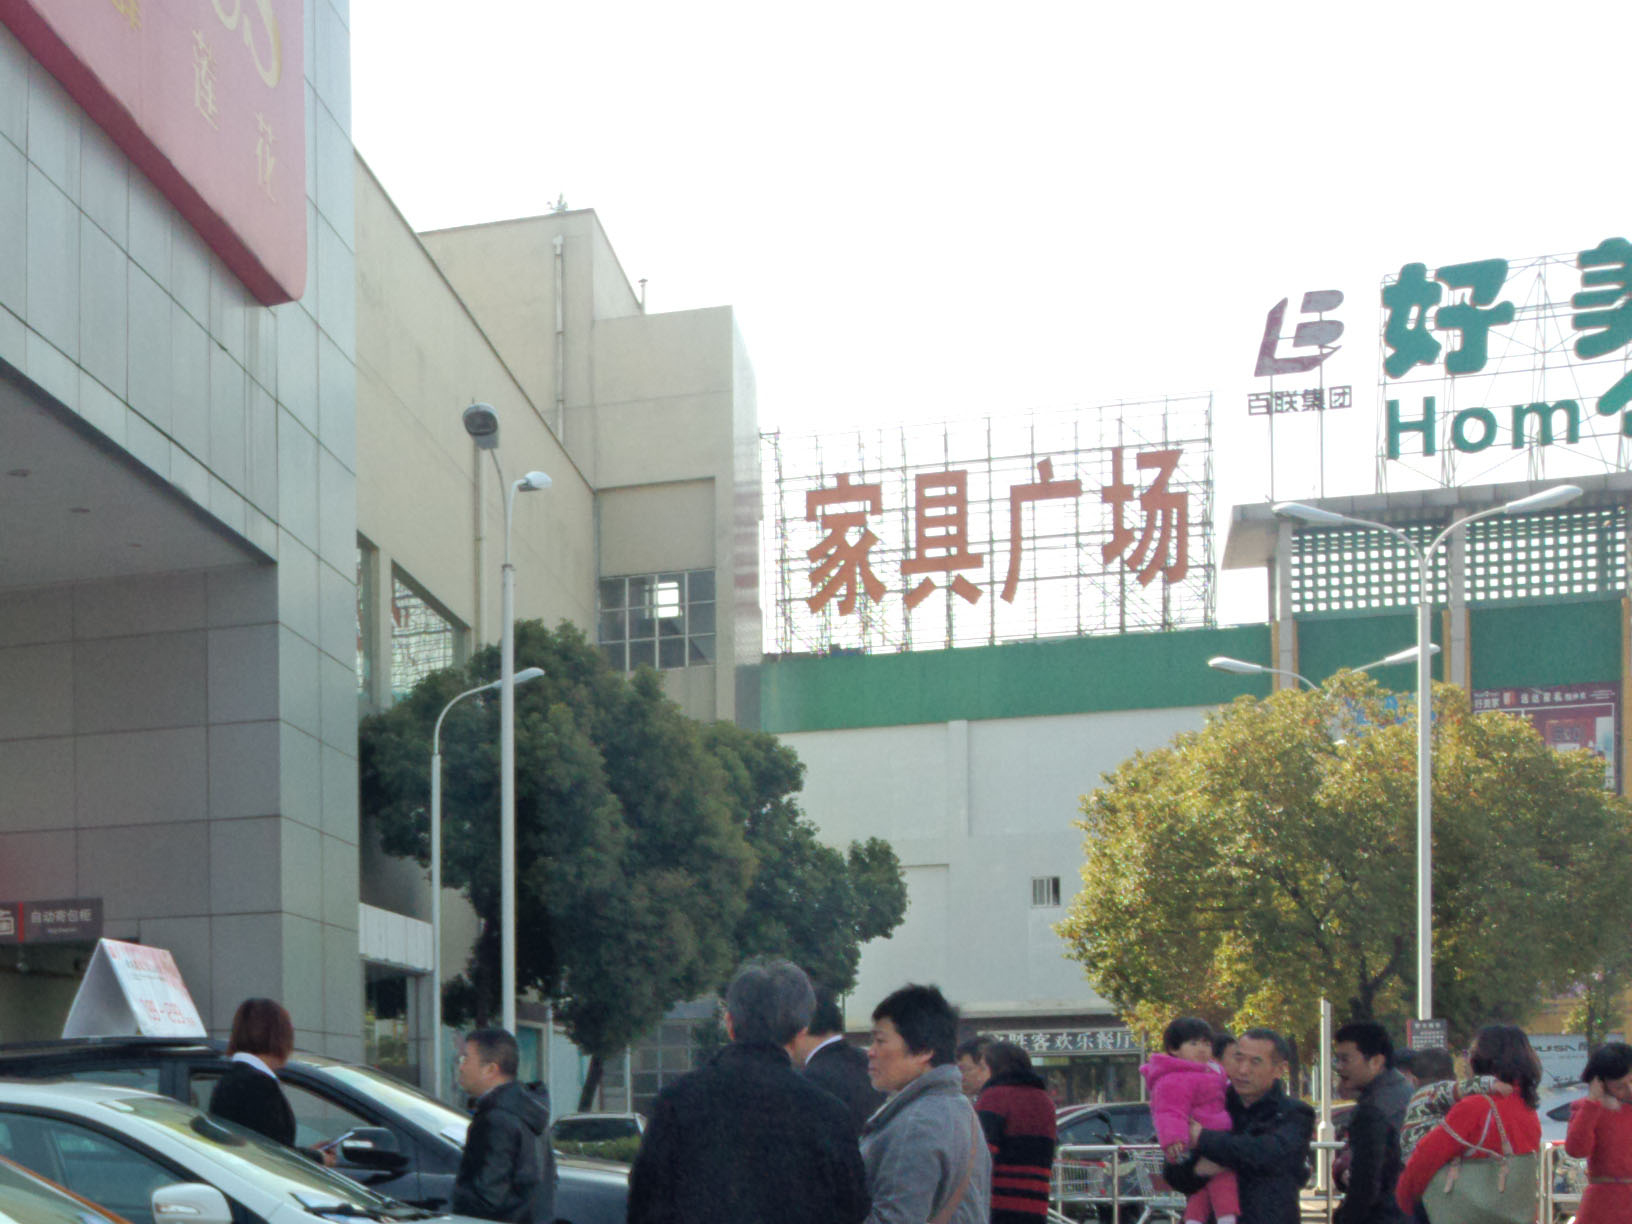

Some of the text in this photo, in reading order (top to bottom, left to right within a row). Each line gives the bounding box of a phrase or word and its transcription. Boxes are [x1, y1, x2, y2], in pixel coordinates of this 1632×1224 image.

[1247, 385, 1352, 416] 百联集团
[806, 446, 1189, 616] 家具广场
